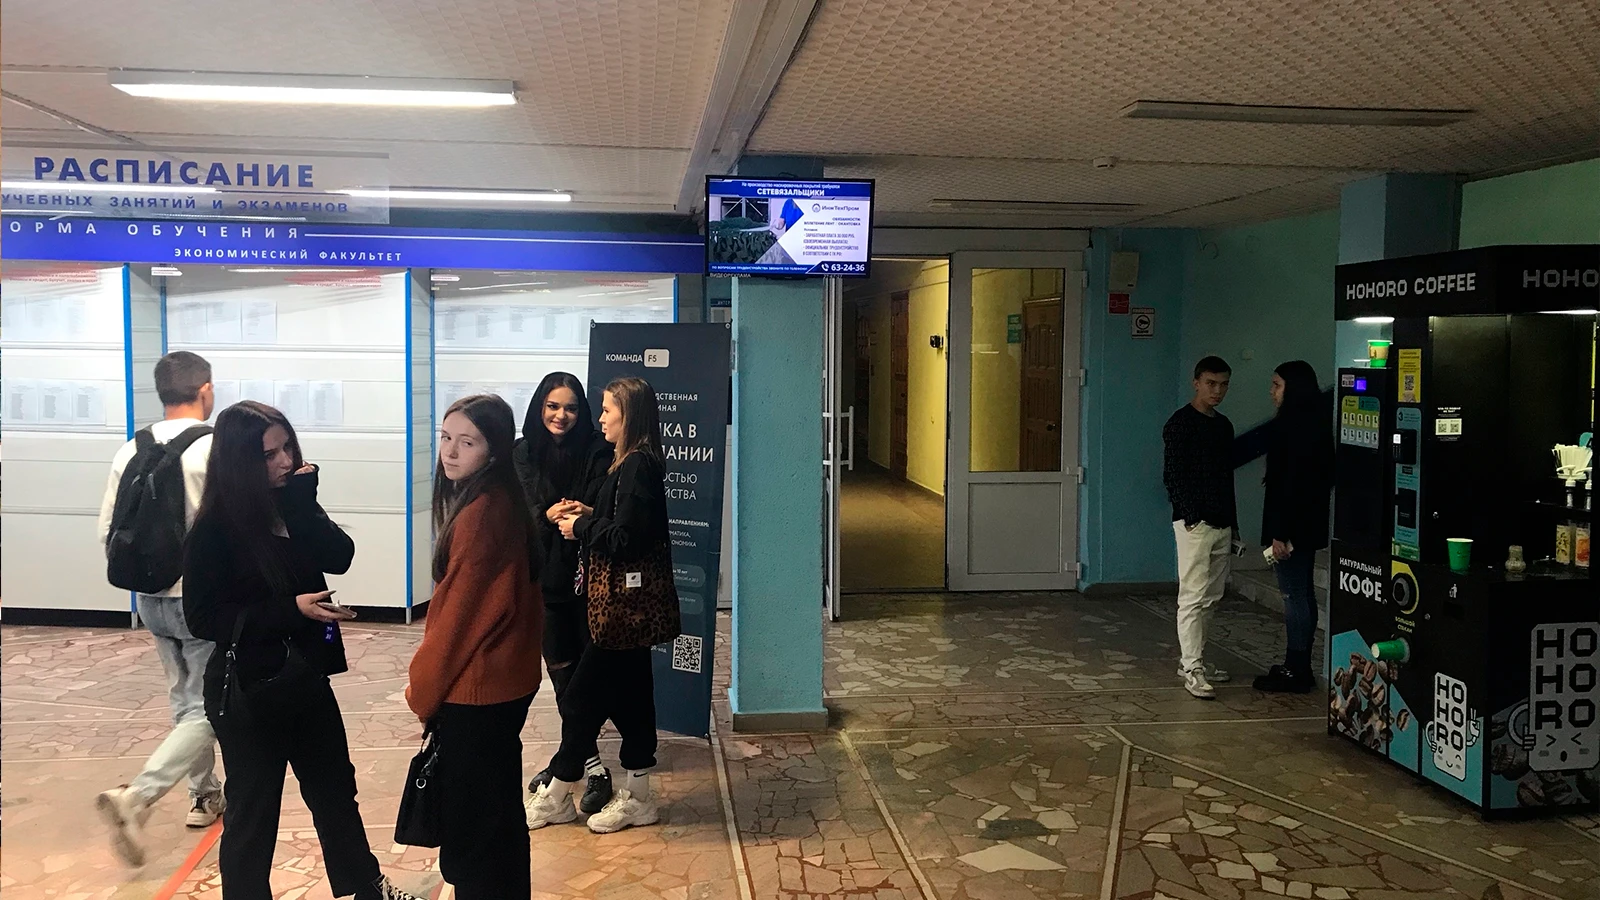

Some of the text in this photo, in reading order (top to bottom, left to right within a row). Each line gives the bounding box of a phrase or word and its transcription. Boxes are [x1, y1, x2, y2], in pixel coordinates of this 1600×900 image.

[34, 156, 315, 188] РАСПИСАНИЕ
[757, 188, 825, 197] СЕТЕВЯЗАЛЬЩИКИ
[2, 194, 348, 213] УЧЕБНЫХ ЗАНЯТИЙ И ЭКЗАМЕНОВ
[127, 223, 298, 239] ОБУЧЕНИЯ
[174, 248, 402, 262] ЭКОНОМИЧЕСКИЙ ФАКУЛЬТЕТ
[831, 263, 865, 272] 63-24-36
[1346, 272, 1477, 300] HOHORO COFFEE
[1522, 268, 1599, 288] HOHO
[605, 353, 657, 363] КОМАНДА F5
[1398, 411, 1403, 421] 3
[659, 422, 697, 439] КА В
[1339, 557, 1382, 576] НАТУРАЛЬНЫЙ
[1339, 570, 1383, 603] КОФЕ
